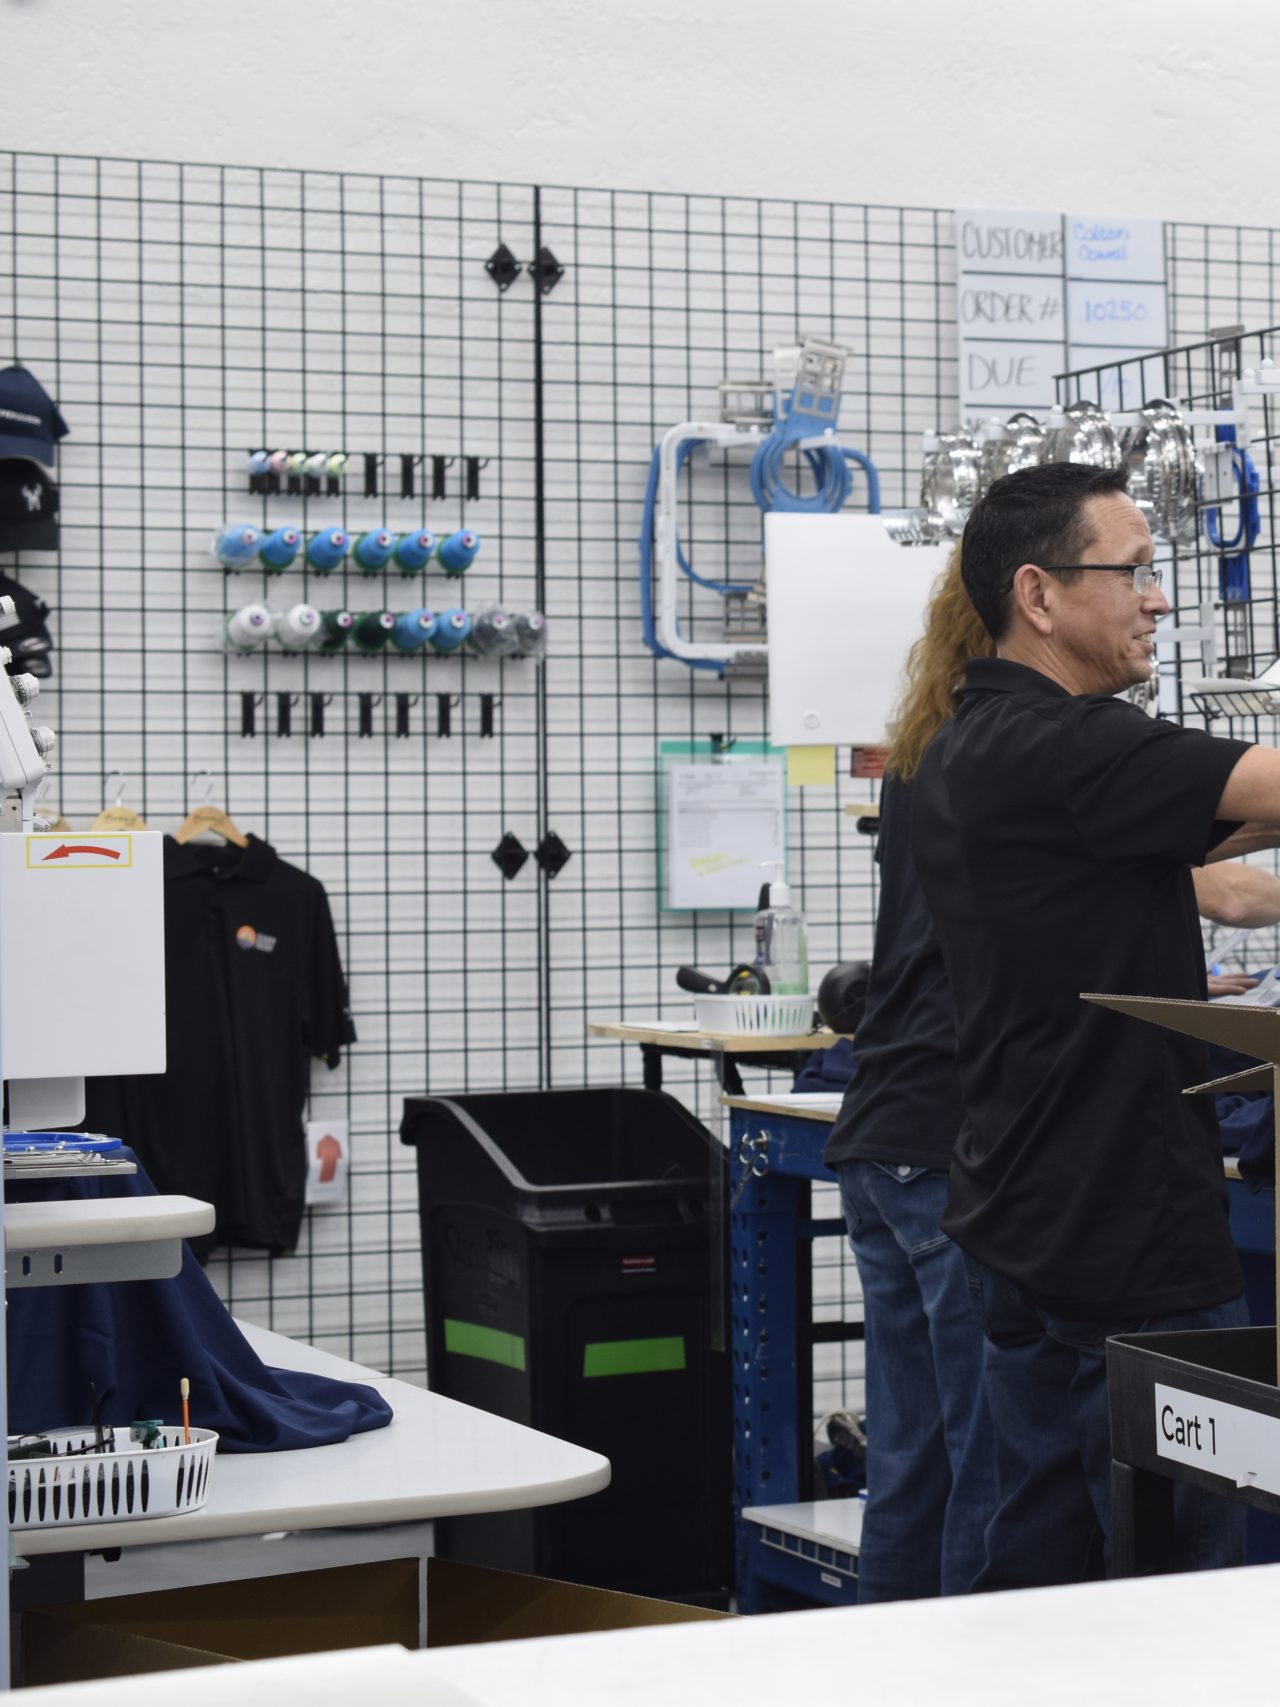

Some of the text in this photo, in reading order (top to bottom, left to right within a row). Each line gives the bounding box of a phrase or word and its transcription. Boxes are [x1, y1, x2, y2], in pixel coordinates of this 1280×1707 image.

[962, 221, 1064, 262] CUSTOMER
[961, 289, 1060, 323] ORDER #
[1085, 299, 1147, 322] 10250
[968, 354, 1037, 391] DUE
[1161, 1405, 1216, 1455] Cart 1
